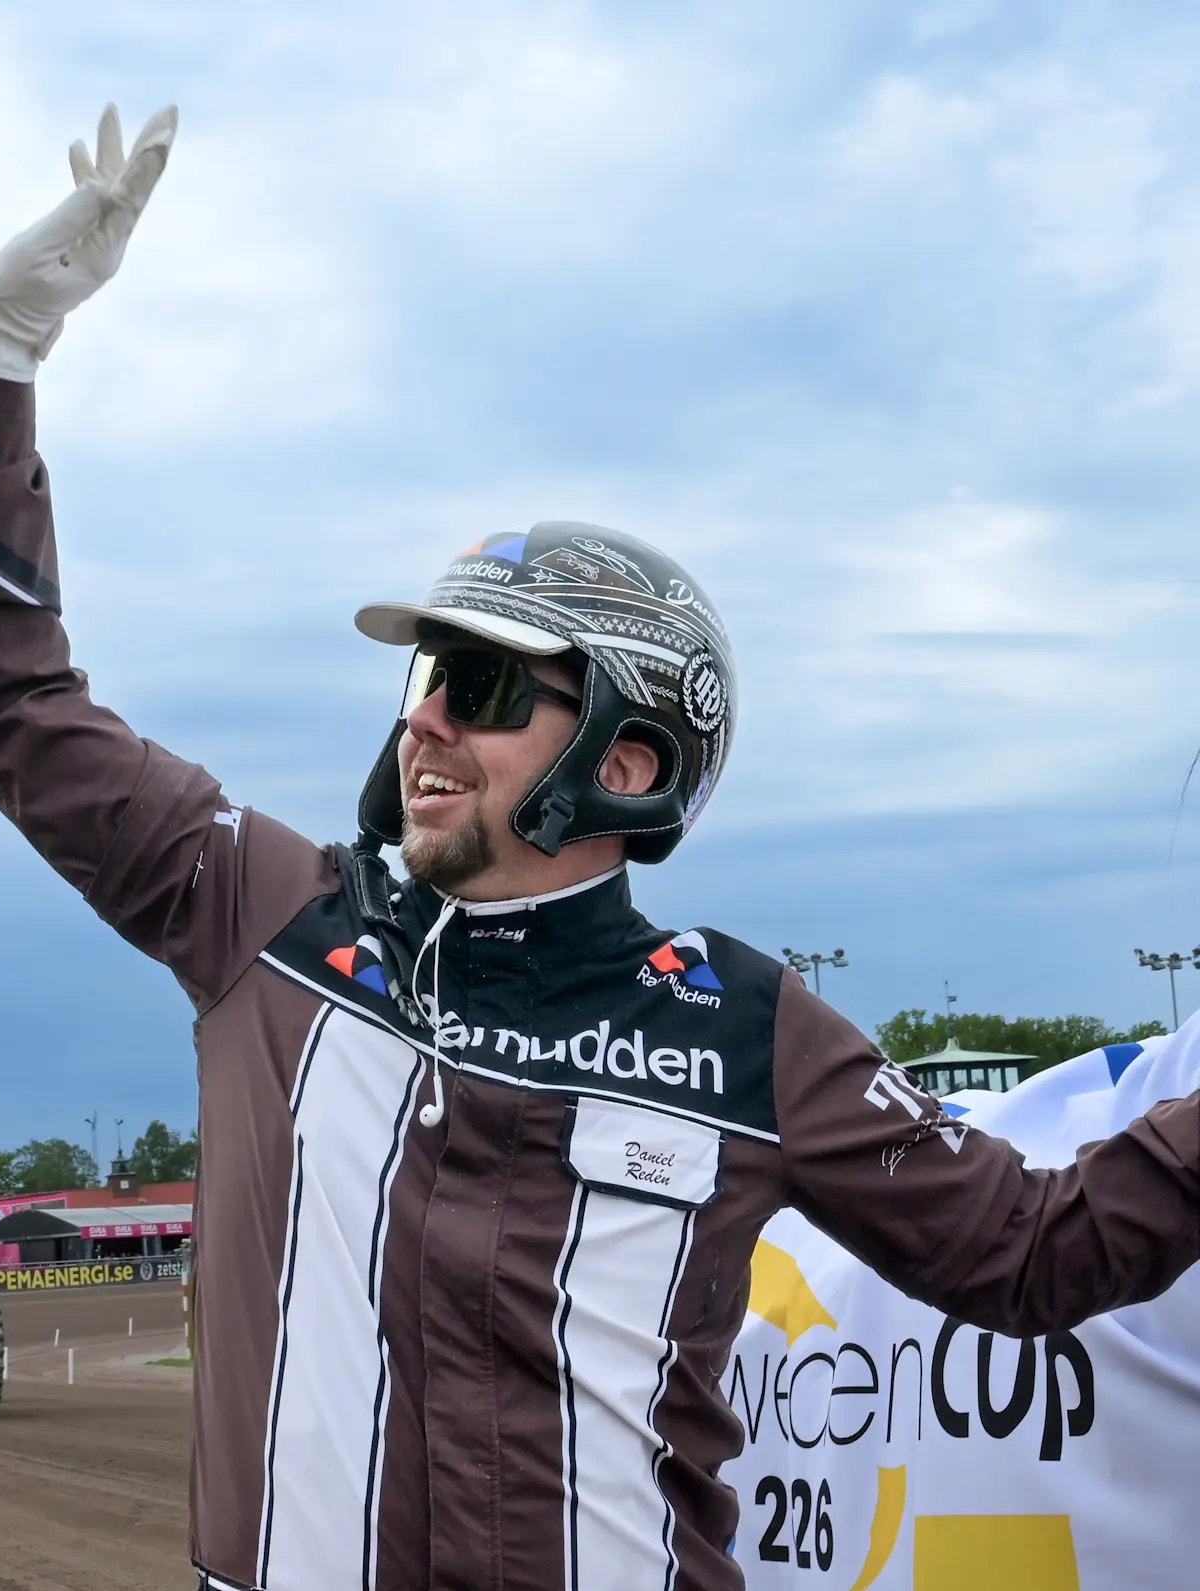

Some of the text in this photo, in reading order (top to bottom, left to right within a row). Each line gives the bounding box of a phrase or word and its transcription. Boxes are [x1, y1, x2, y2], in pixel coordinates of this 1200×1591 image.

[625, 1141, 676, 1167] Daniel
[625, 1161, 670, 1185] Redén
[89, 1223, 183, 1236] SVEA SVEA SVEA SVEA
